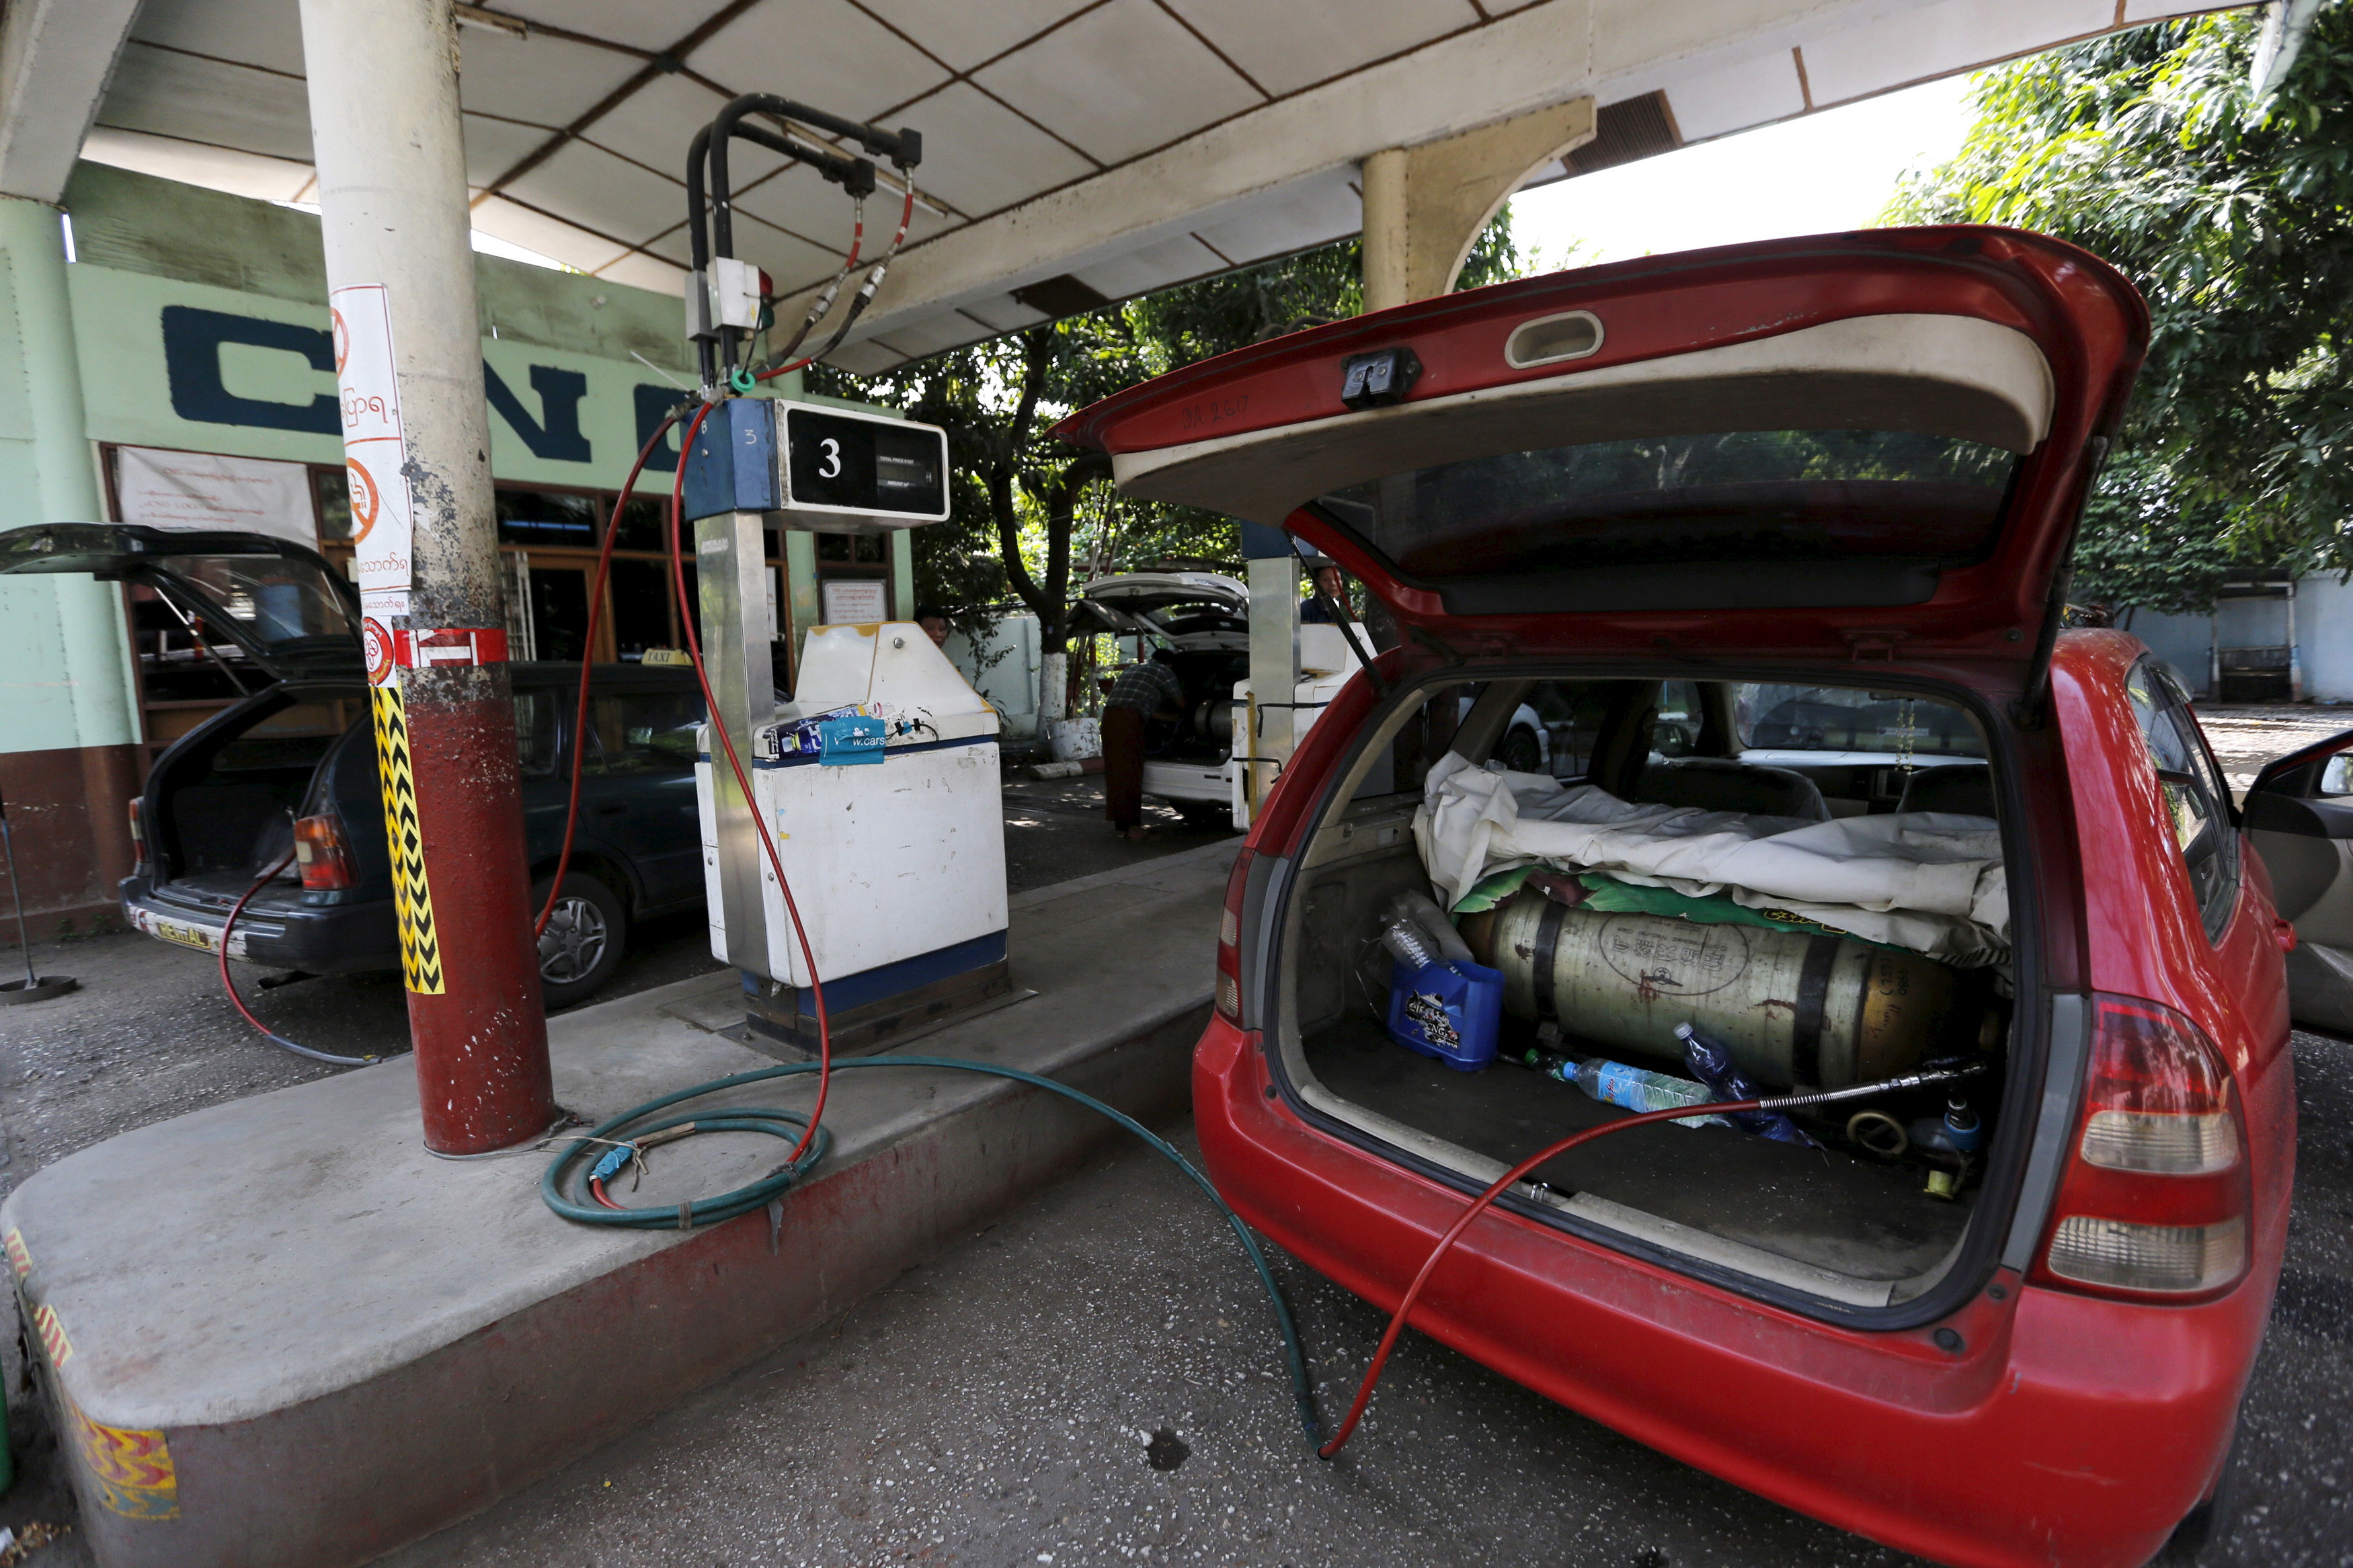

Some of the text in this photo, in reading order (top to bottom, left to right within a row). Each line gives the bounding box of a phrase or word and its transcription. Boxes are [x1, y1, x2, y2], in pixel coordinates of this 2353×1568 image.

[744, 429, 756, 444] 3
[818, 438, 841, 478] 3
[647, 652, 670, 663] TAXI
